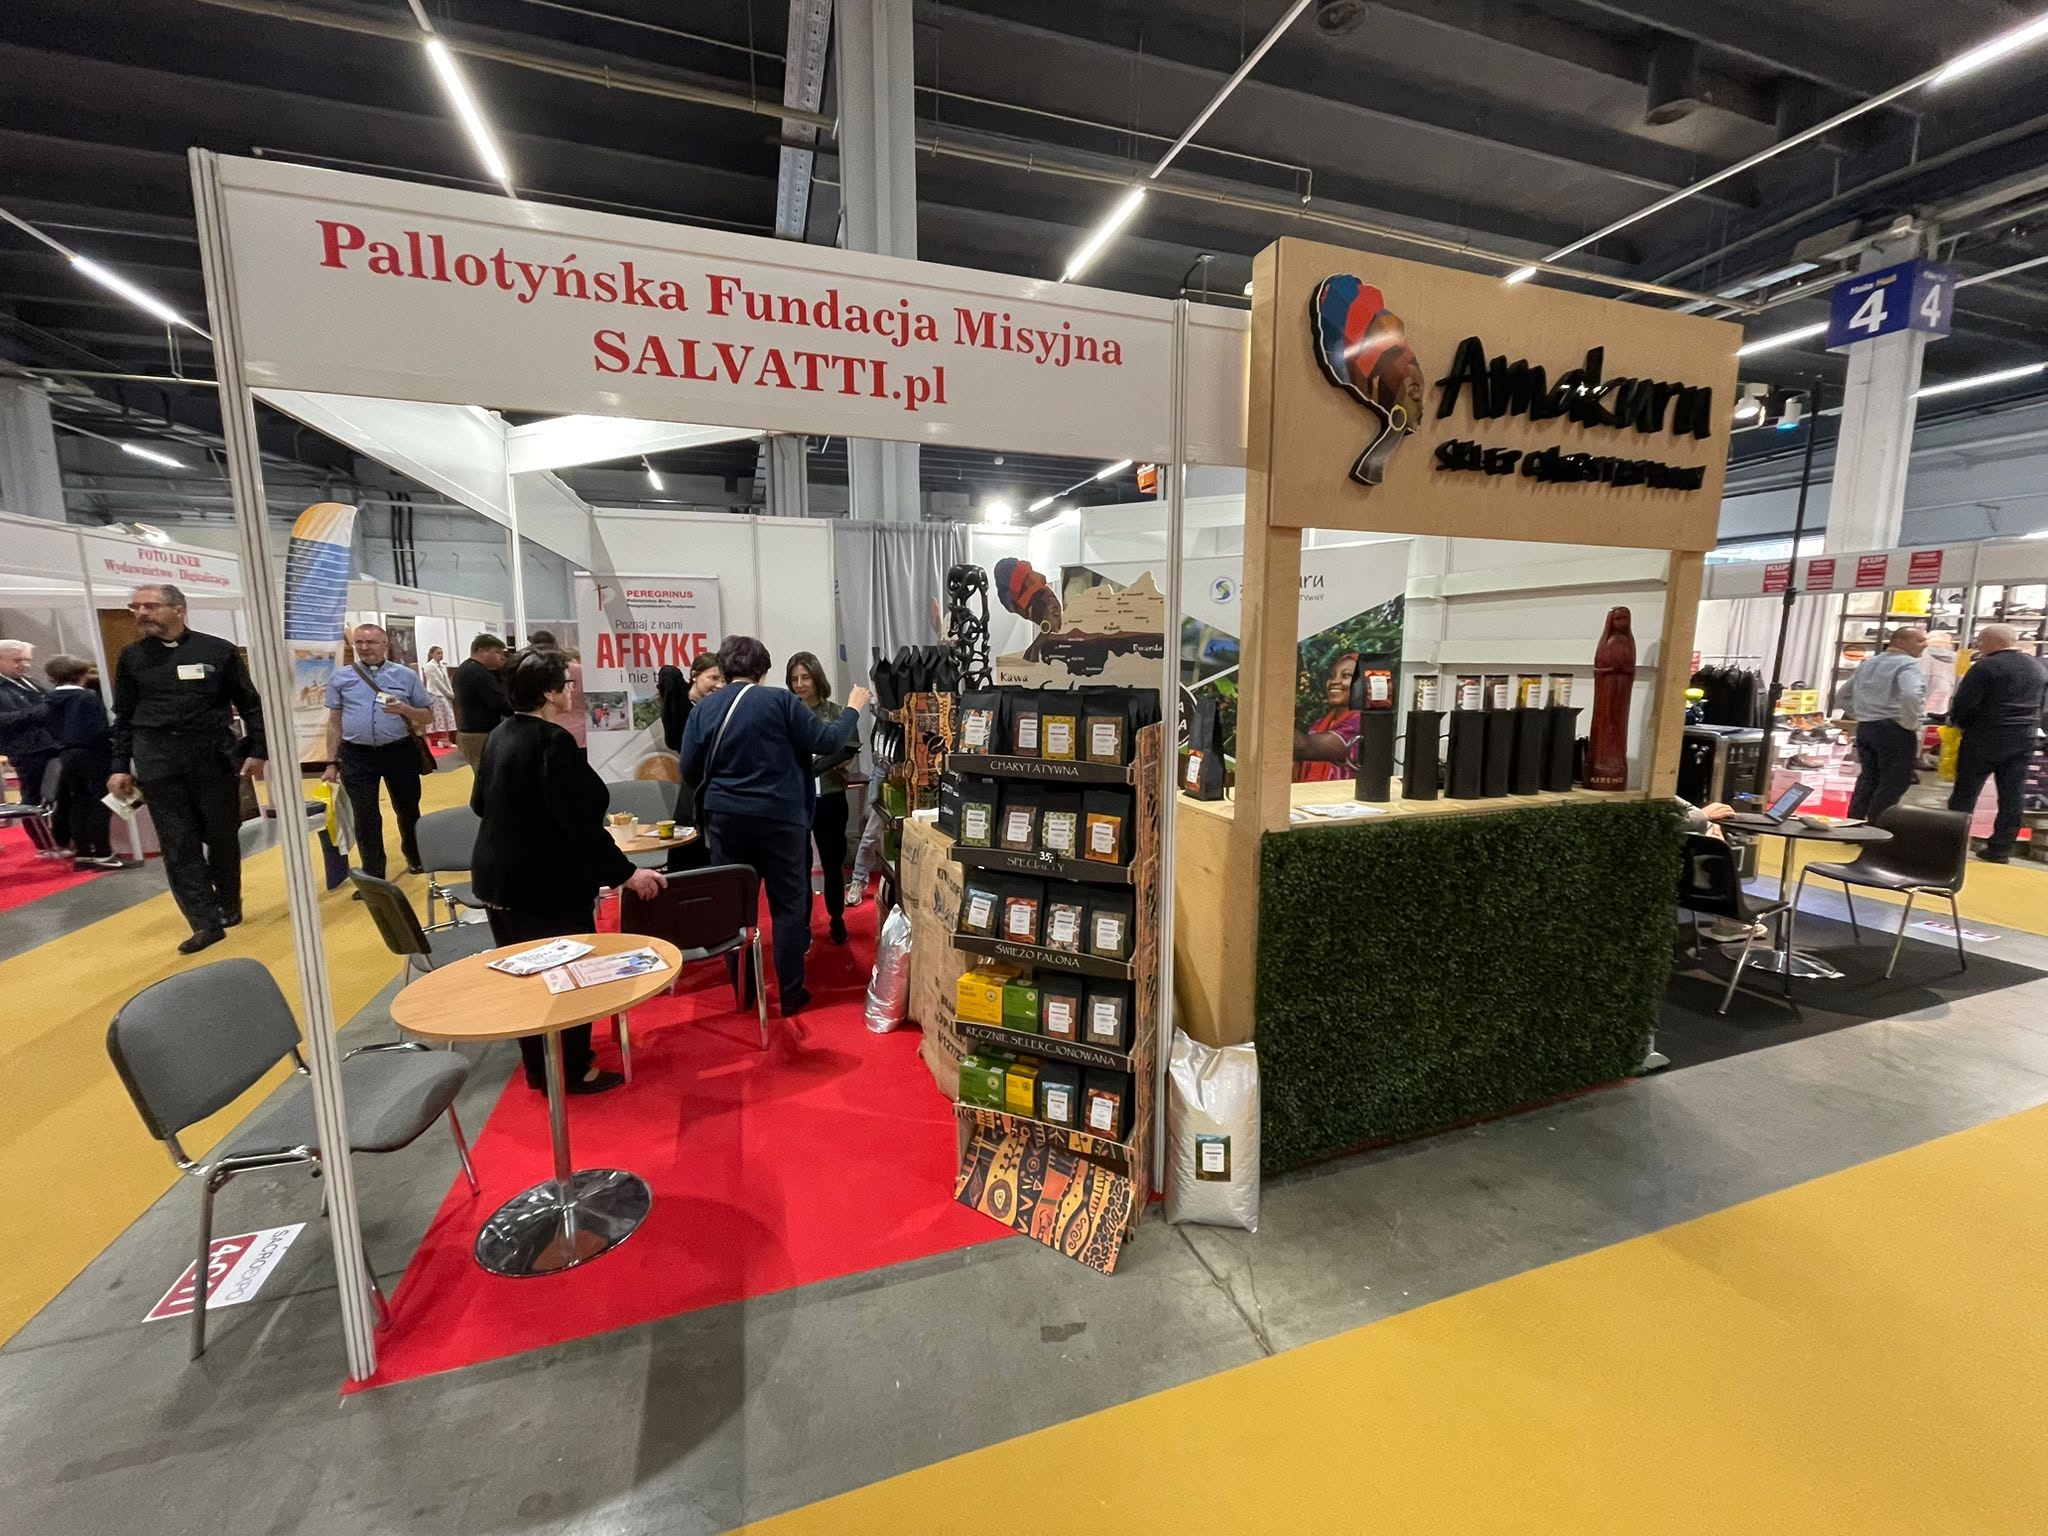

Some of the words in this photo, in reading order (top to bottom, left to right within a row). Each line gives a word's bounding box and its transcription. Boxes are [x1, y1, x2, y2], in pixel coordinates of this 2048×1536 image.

[316, 220, 688, 311] Pallotyńska
[705, 274, 938, 347] Fundacja
[954, 308, 1123, 367] Misyjna
[1849, 288, 1888, 333] 4
[1920, 284, 1941, 327] 4
[594, 330, 947, 411] SALVATTI.pl
[1436, 336, 1712, 440] Amakuru
[138, 548, 168, 562] FOTO
[170, 553, 201, 567] LINER
[626, 590, 693, 599] PEREGRINUS
[615, 619, 647, 631] Poznaj
[651, 622, 655, 630] z
[659, 620, 683, 630] nami
[1132, 643, 1163, 652] Rwanda
[628, 670, 648, 683] nie
[1000, 672, 1029, 683] Kawa
[990, 760, 1079, 776] CHARYTATYWNA
[1036, 950, 1080, 968] PALONA
[1010, 1035, 1115, 1066] SELEKCJONOWANA
